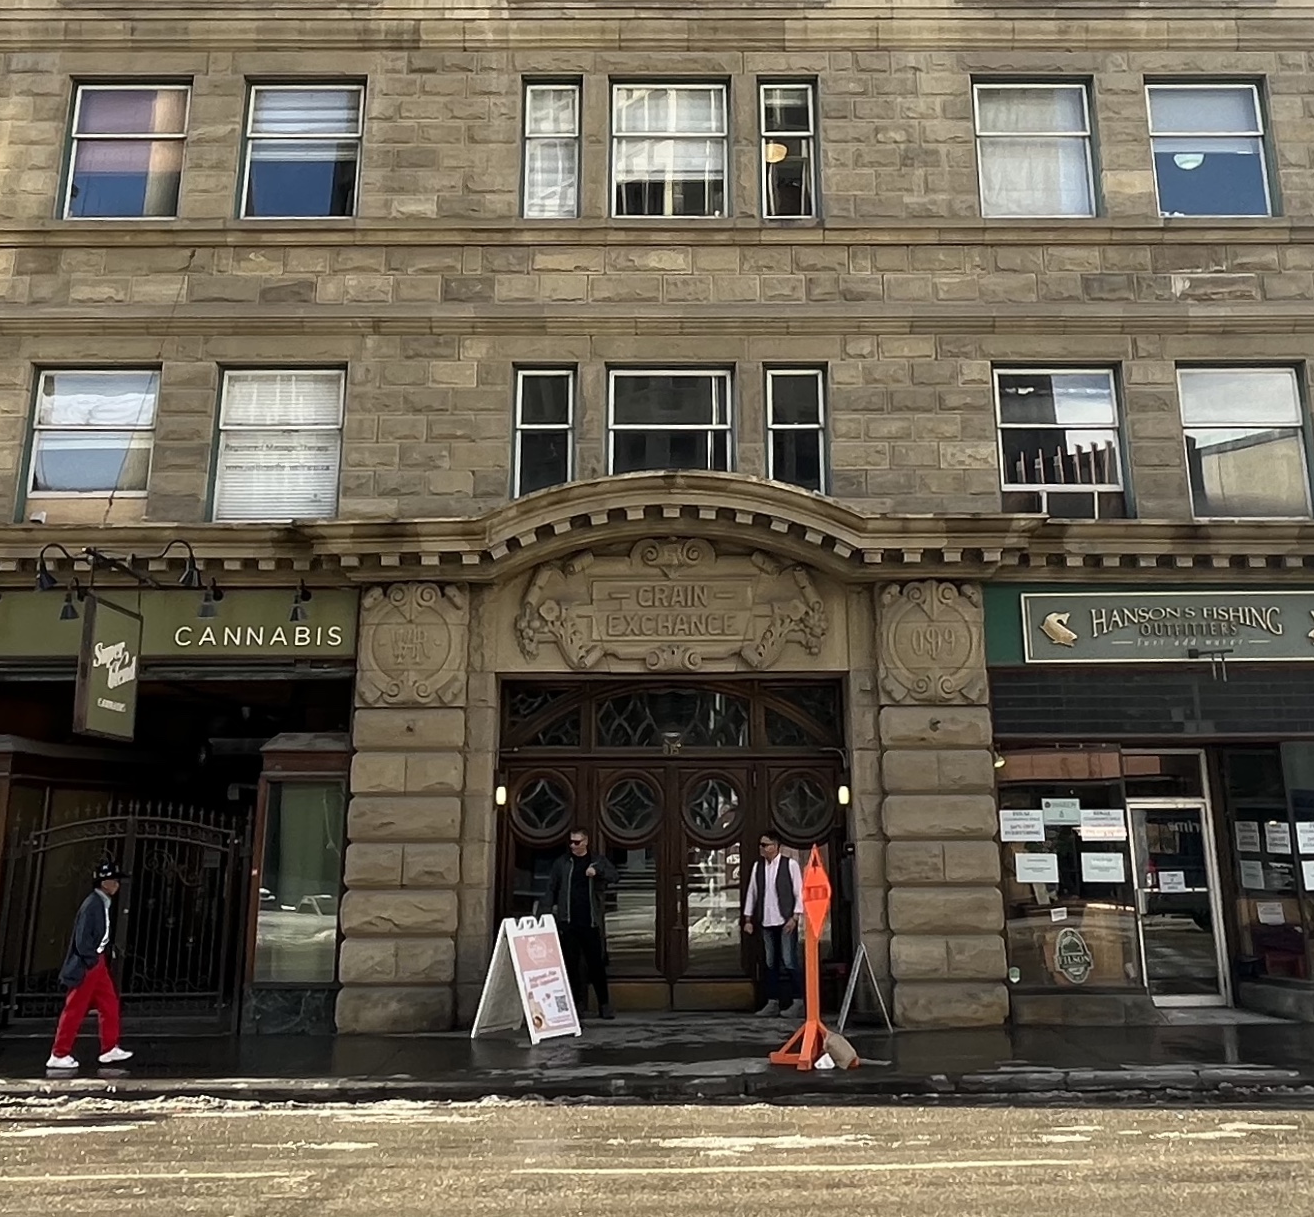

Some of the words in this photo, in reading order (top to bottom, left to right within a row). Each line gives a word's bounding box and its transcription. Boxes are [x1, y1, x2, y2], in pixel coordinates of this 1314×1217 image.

[637, 585, 708, 608] GRAIN
[606, 613, 737, 637] EXCHANGE
[1140, 621, 1237, 636] OUTFITTERS
[1202, 606, 1283, 635] FISHING
[174, 626, 343, 646] CANNABIS
